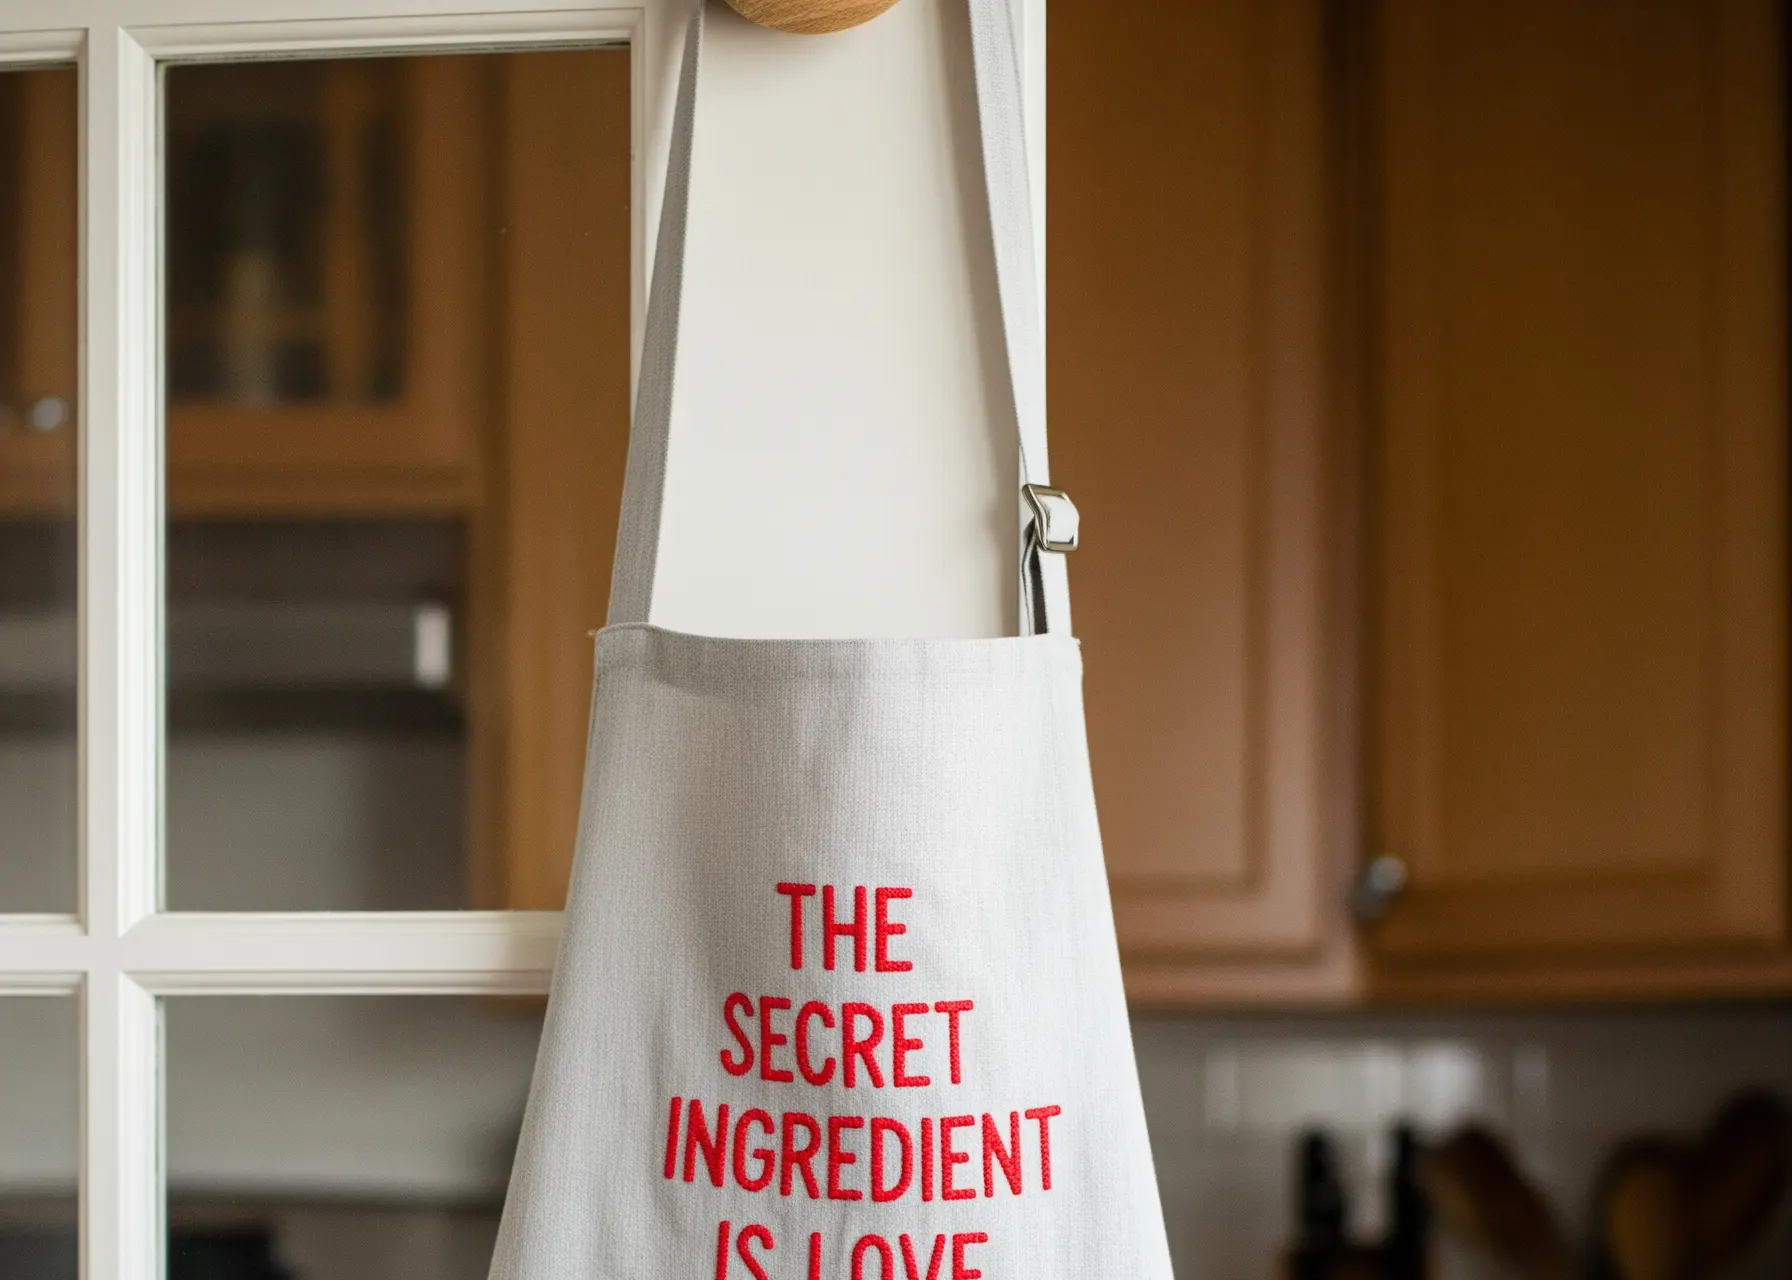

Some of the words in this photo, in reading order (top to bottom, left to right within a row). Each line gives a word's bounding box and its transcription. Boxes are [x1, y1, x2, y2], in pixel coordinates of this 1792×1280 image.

[776, 881, 914, 973] THE
[719, 991, 974, 1089] SECRET
[663, 1095, 1062, 1203] INGREDIENT
